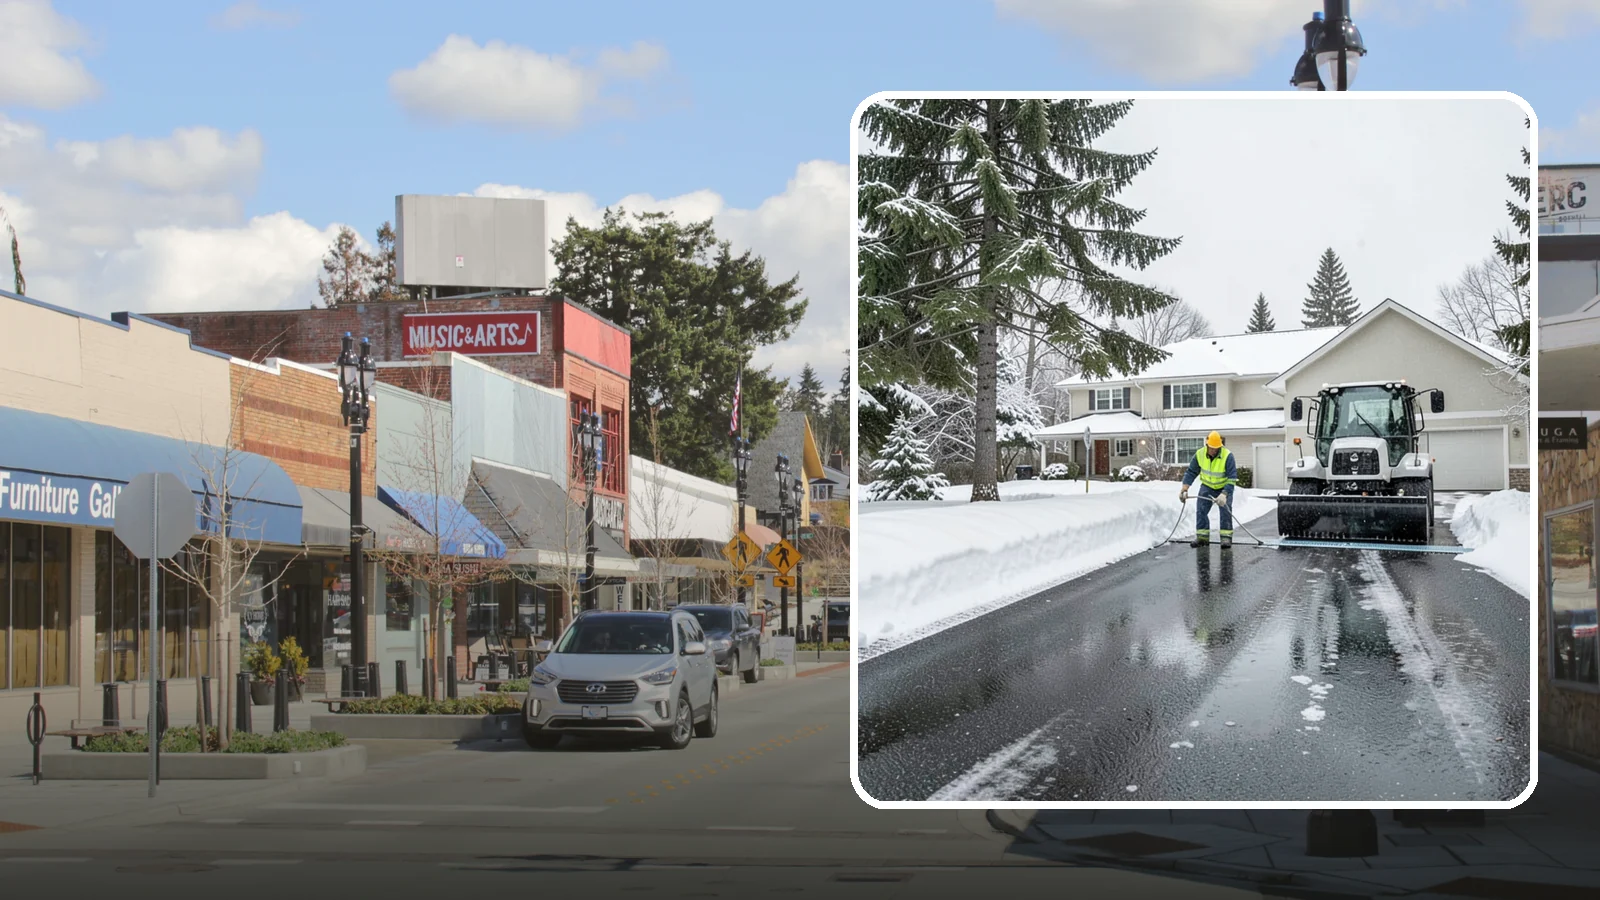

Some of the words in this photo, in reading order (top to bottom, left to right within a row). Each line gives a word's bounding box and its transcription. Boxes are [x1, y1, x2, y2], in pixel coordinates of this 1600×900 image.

[409, 323, 519, 348] MUSIC&ARTS
[1540, 428, 1577, 437] UGA
[1552, 436, 1579, 444] Framing
[0, 471, 79, 515] Furniture
[89, 482, 122, 519] Gal
[453, 563, 479, 574] SUSHI
